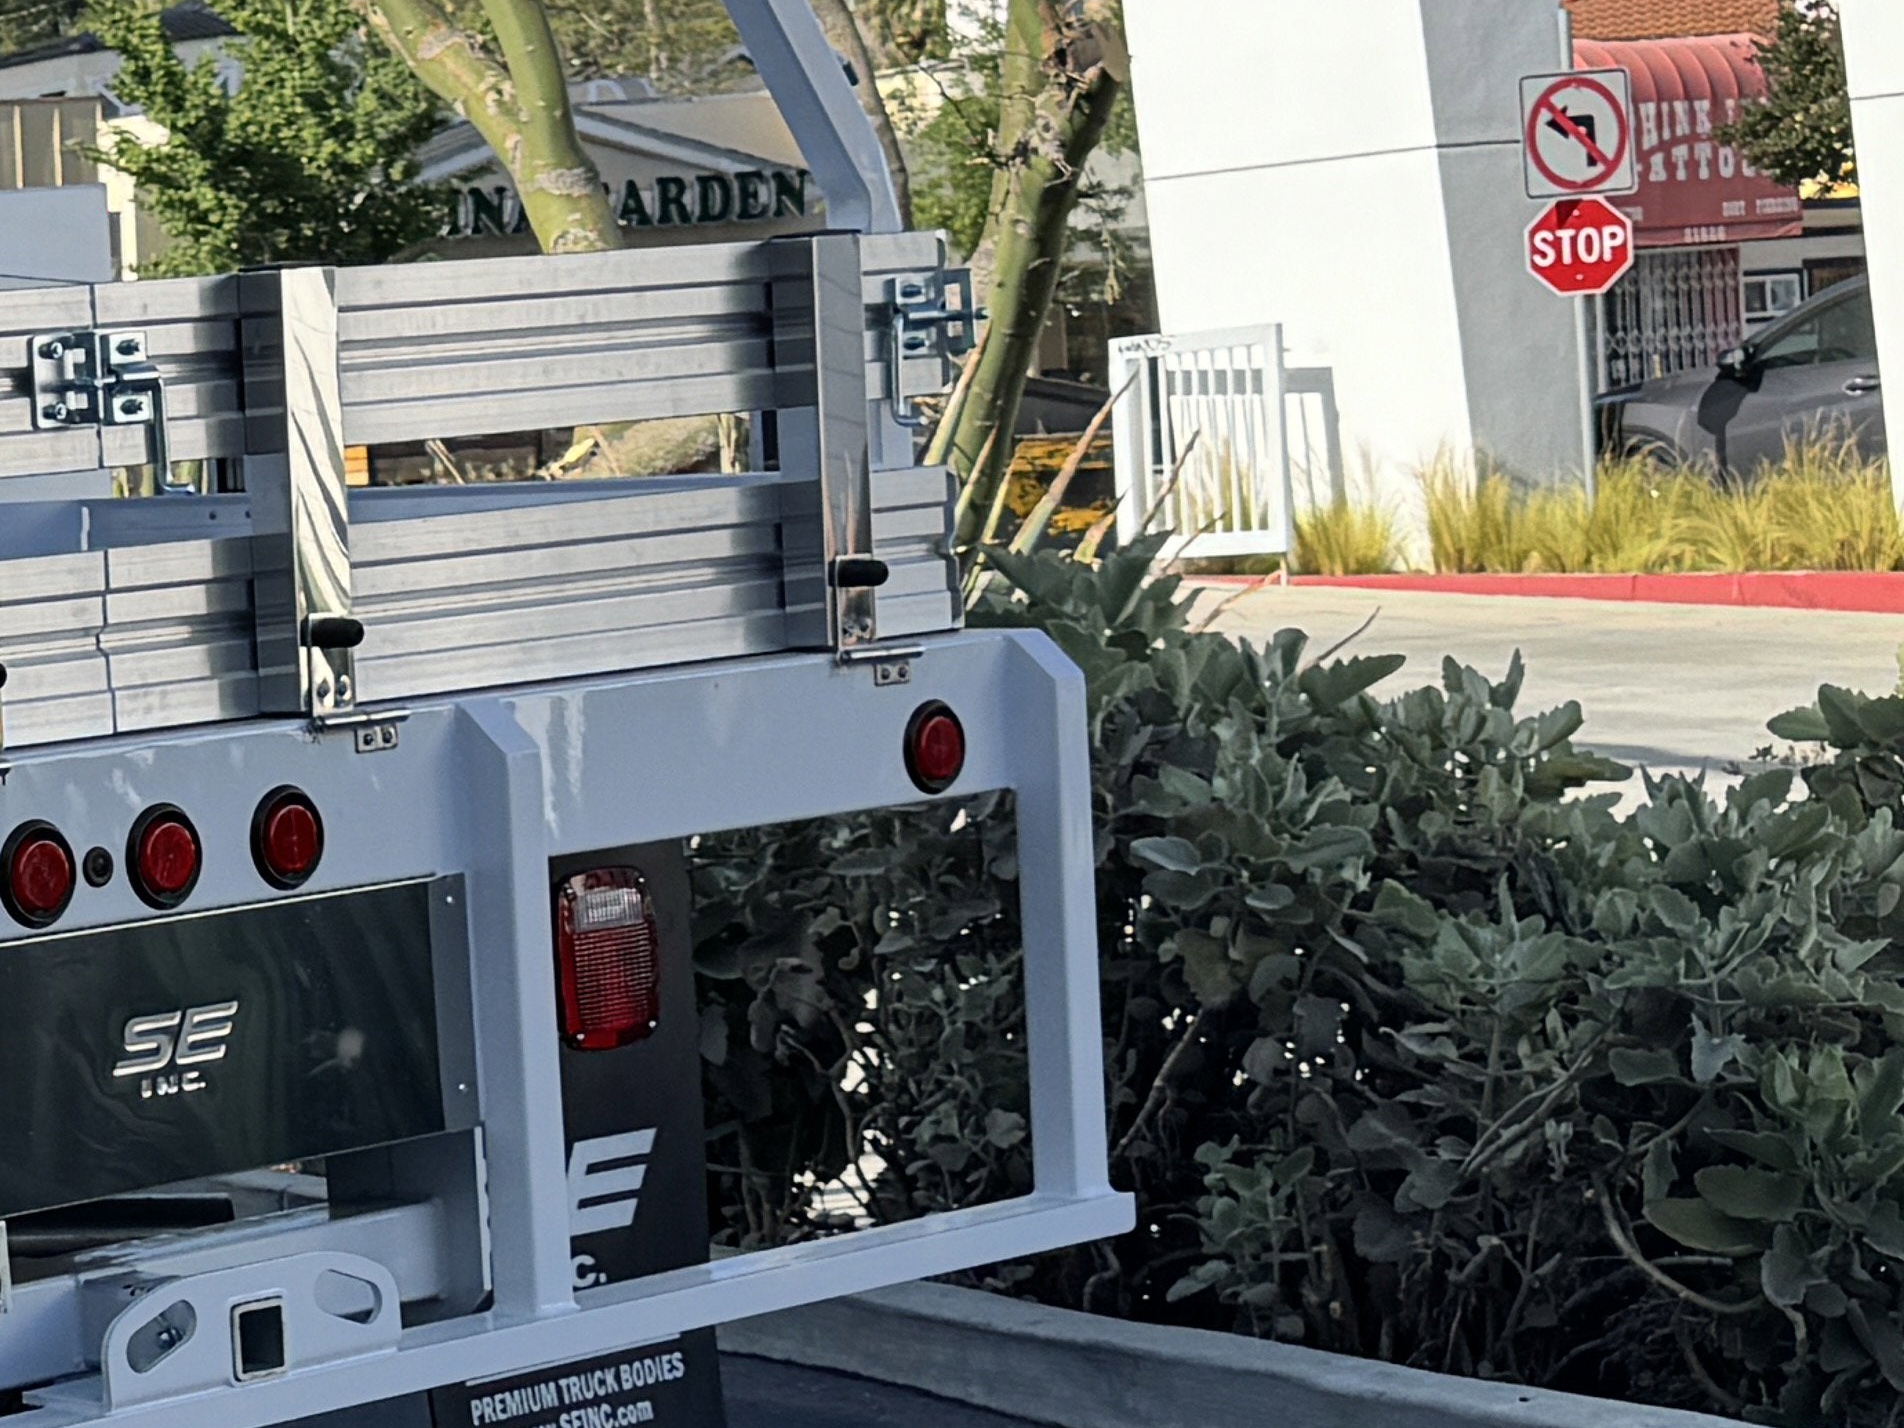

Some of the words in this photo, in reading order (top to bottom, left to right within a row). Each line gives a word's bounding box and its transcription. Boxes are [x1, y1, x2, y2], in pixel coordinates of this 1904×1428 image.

[1633, 99, 1712, 151] HINK
[1637, 141, 1756, 182] ATTO
[602, 169, 812, 228] ARDEN
[1532, 227, 1625, 267] STOP
[113, 1000, 238, 1077] SE
[567, 1127, 657, 1238] E
[470, 1380, 559, 1426] PREMIUM
[558, 1367, 619, 1405] TRUCK
[619, 1352, 685, 1390] BODIES
